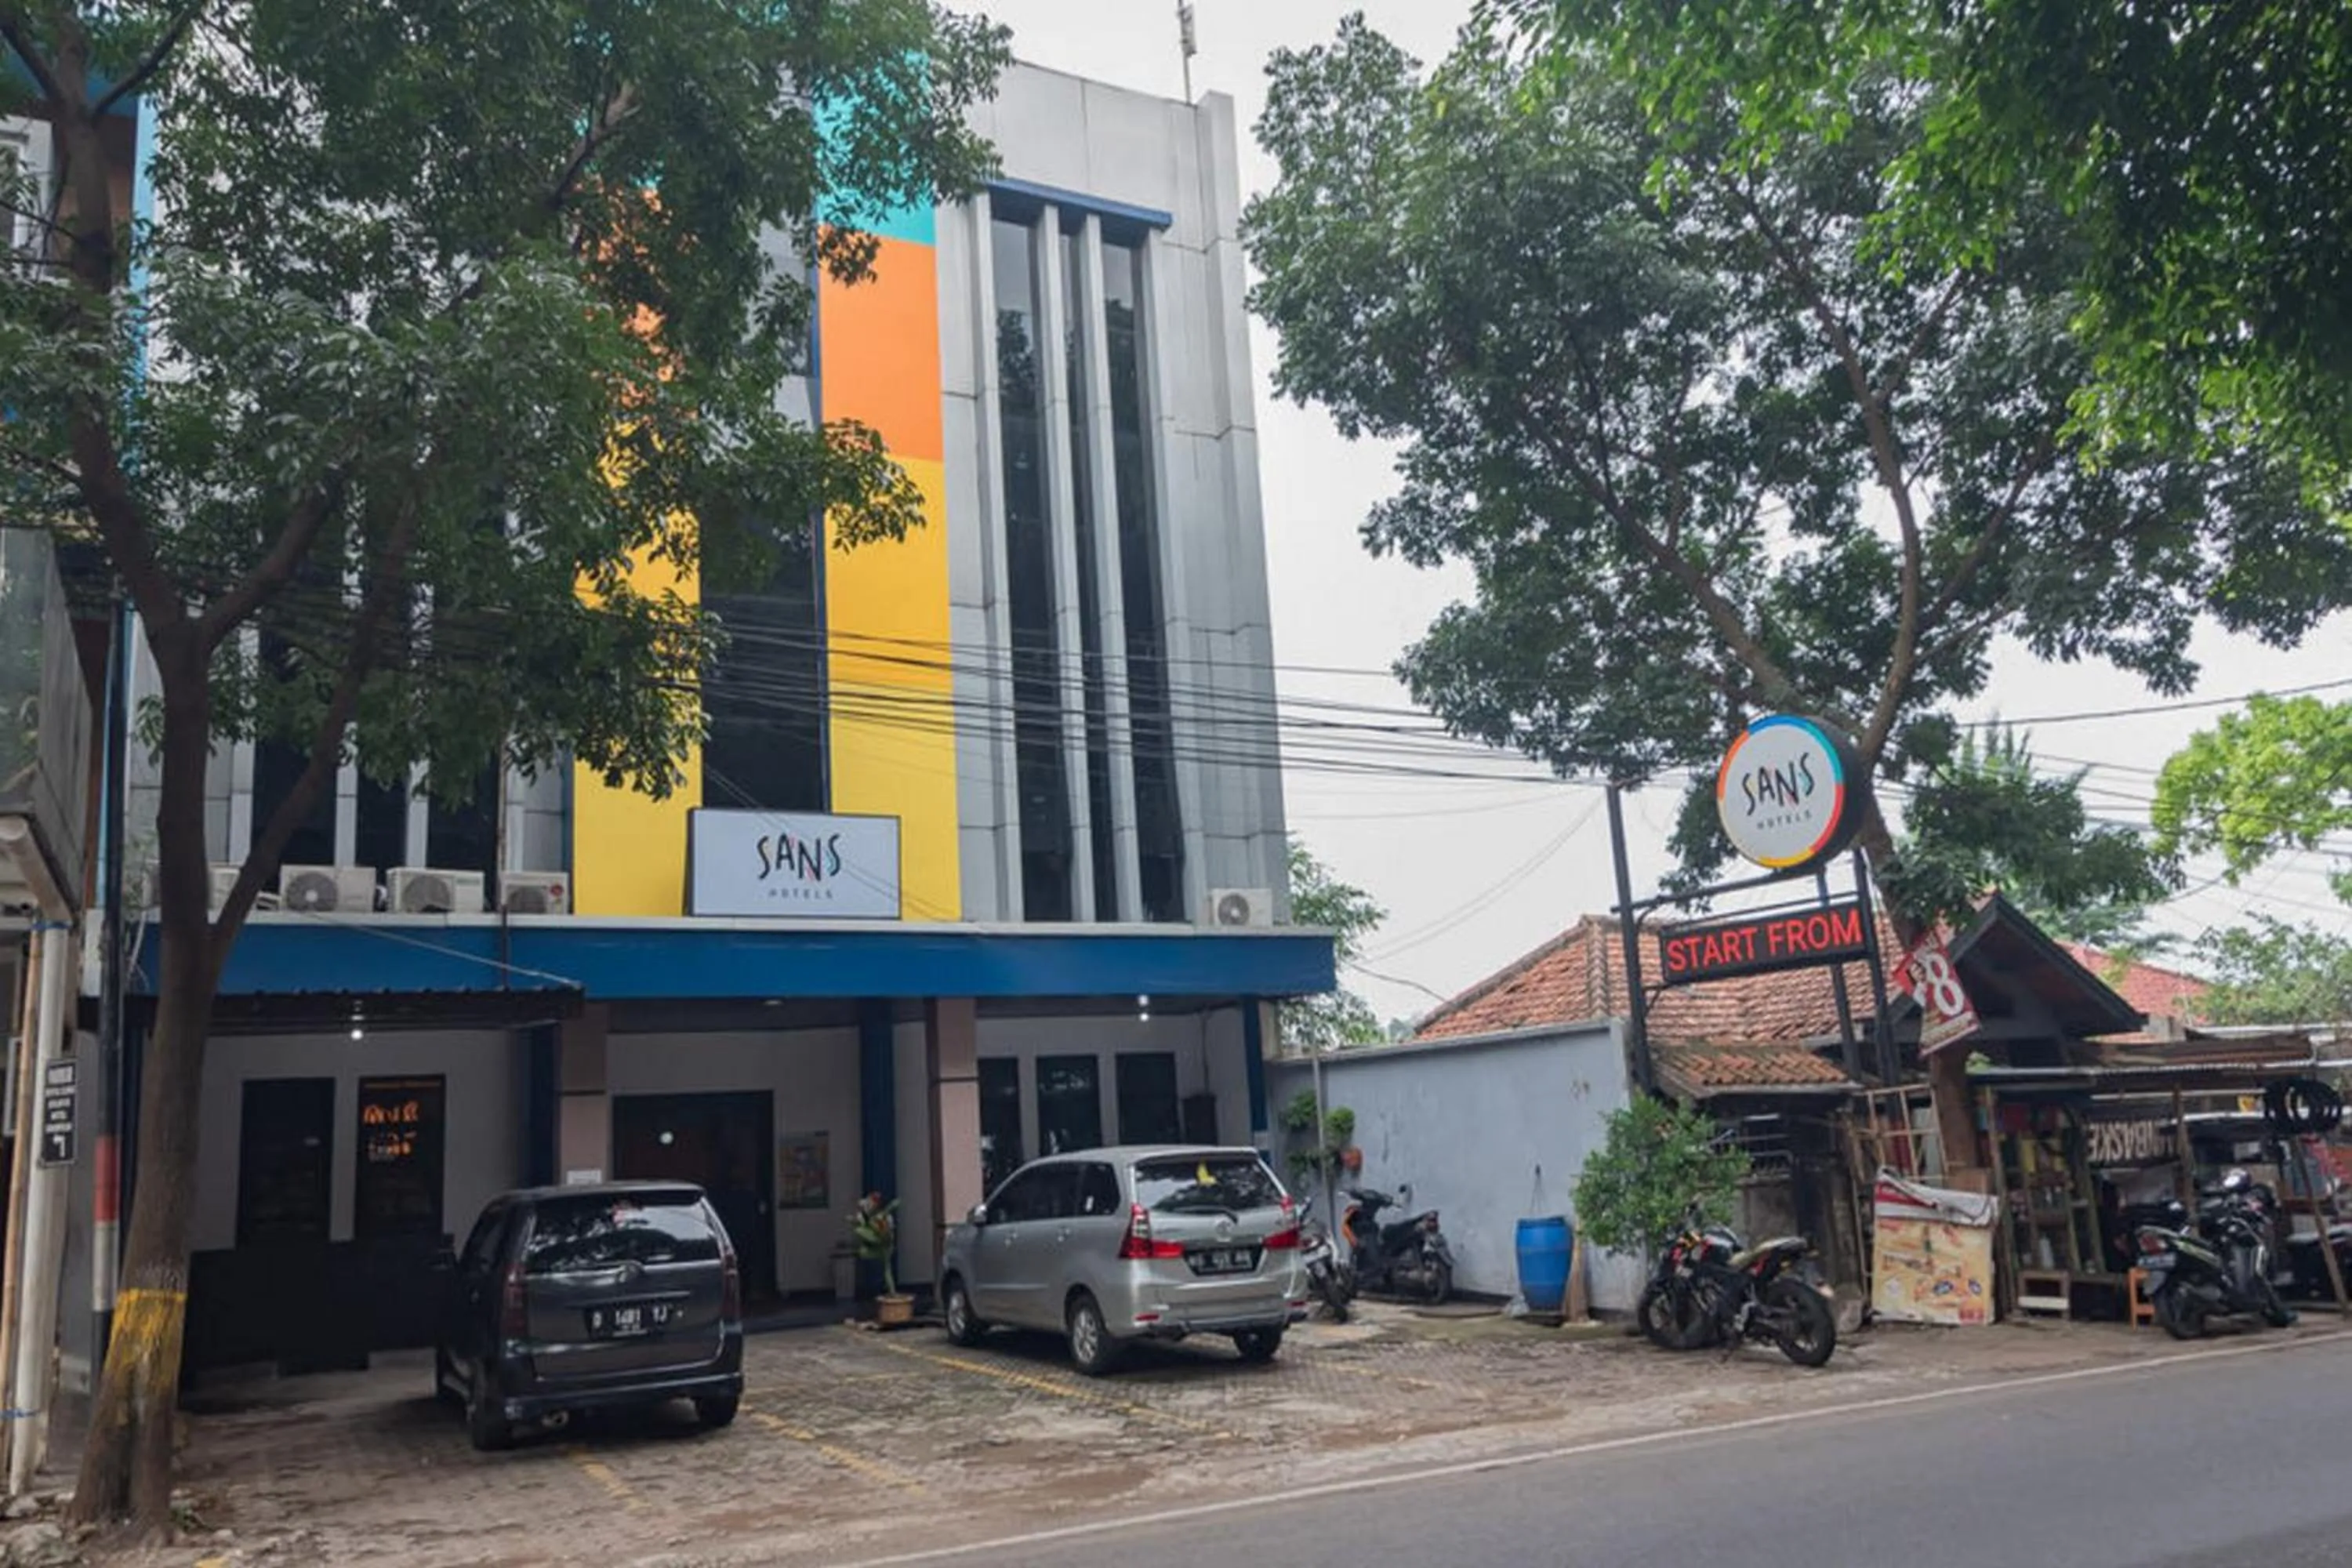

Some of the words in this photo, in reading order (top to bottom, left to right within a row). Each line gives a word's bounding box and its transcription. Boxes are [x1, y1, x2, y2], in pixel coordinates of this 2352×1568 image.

[1742, 752, 1815, 816] SANS
[756, 833, 841, 881] SANS
[768, 887, 833, 900] HOTELS
[1666, 926, 1759, 971] START
[1767, 908, 1864, 957] FROM
